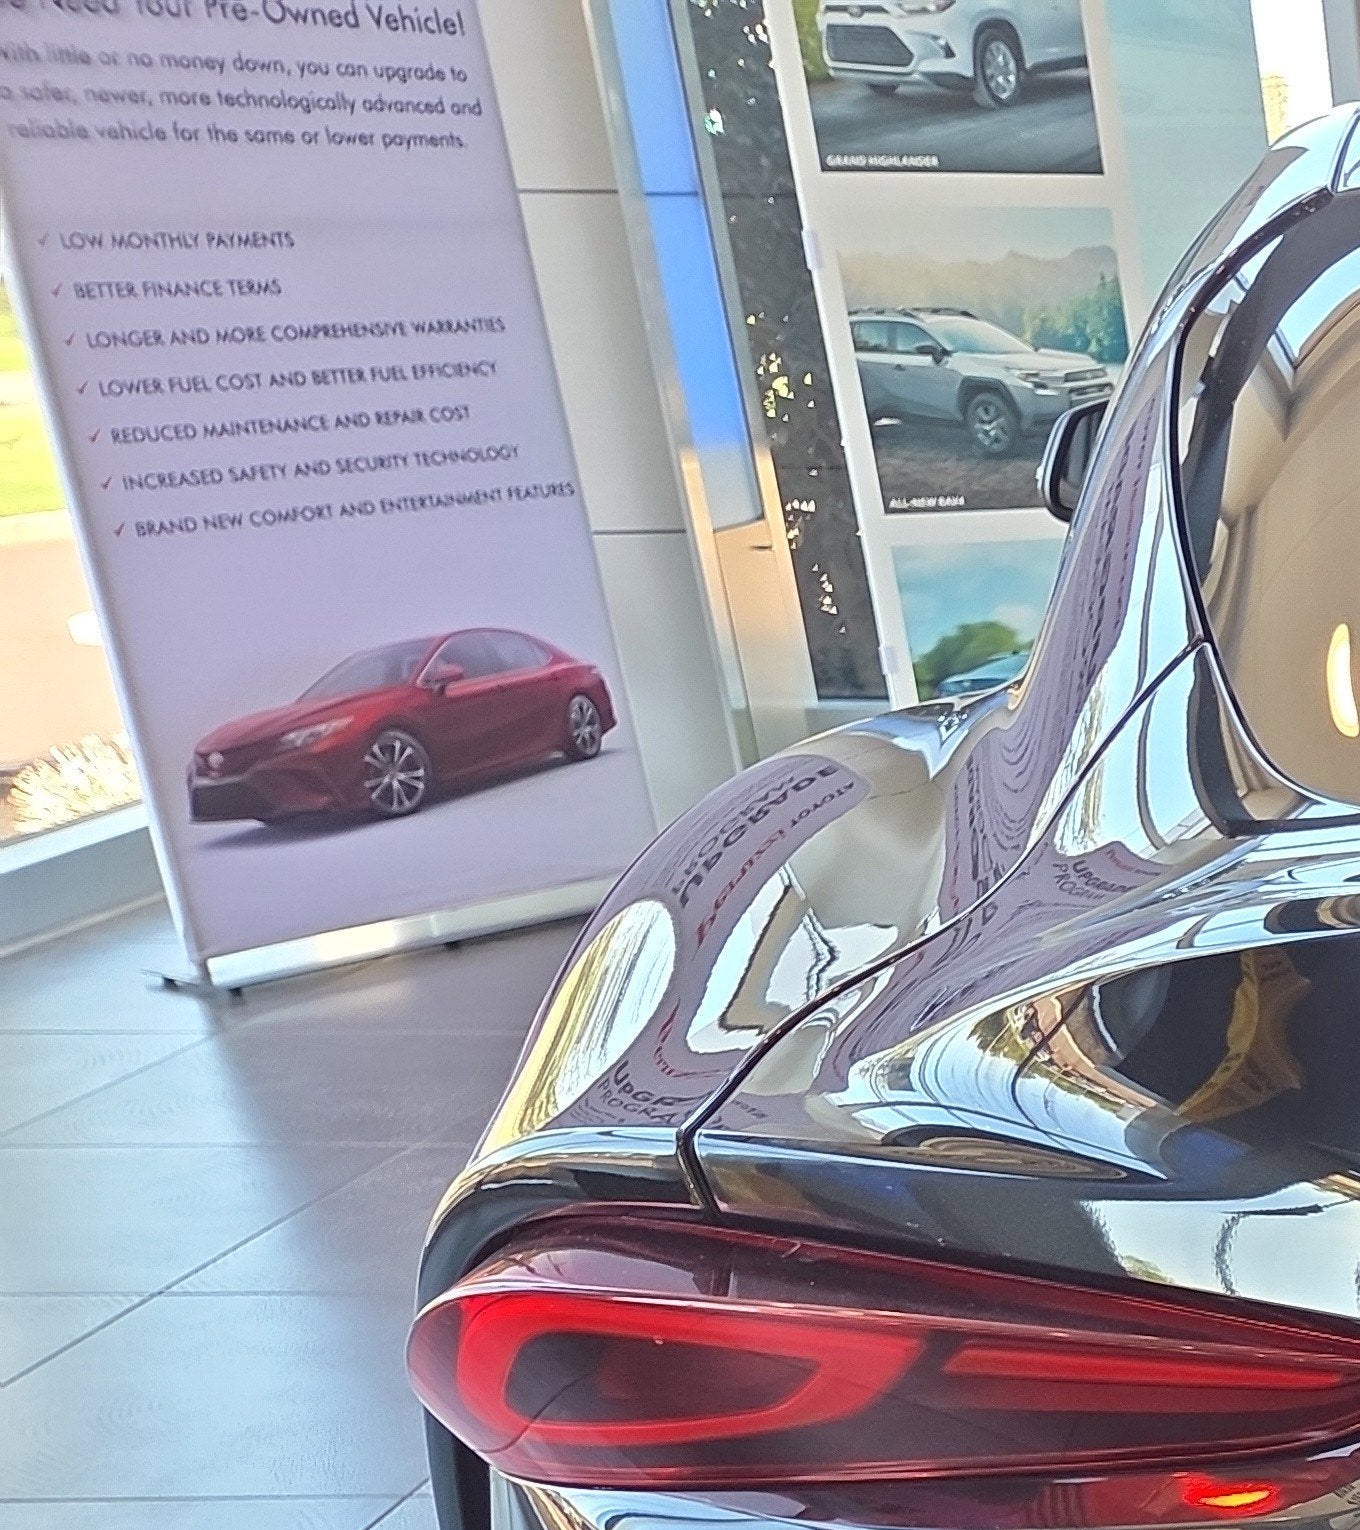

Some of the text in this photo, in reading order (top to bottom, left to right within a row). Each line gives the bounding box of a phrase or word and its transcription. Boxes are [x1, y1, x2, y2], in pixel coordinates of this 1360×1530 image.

[205, 0, 360, 29] Pre-Owned
[366, 3, 466, 37] Vehicle!
[99, 51, 118, 65] or
[127, 52, 153, 68] no
[160, 53, 225, 74] money
[232, 52, 291, 77] down,
[297, 60, 329, 78] you
[336, 61, 368, 78] can
[373, 61, 446, 84] upgrade
[450, 65, 467, 83] to
[84, 87, 152, 106] newer,
[159, 91, 211, 107] more
[217, 88, 355, 116] technologically
[362, 93, 446, 115] advanced
[450, 97, 482, 116] and
[10, 117, 468, 151] reliable vehicle for the same or lower payments.
[60, 231, 295, 250] LOW MONTHLY PAYMENTS
[73, 277, 283, 300] BETTER FINANCE TERMS
[87, 316, 506, 349] LONGER AND MORE COMPREHENSIVE WARRANTIES
[98, 359, 497, 398] LOWER FUEL COST AND BETTER FUEL EFFICIENCY
[110, 404, 471, 445] REDUCED MAINTENANCE AND REPAIR COST
[122, 443, 520, 491] INCREASED SAFETY AND SECURITY TECHNOLOGY
[134, 516, 198, 538] BRAND
[202, 513, 244, 531] NEW
[249, 503, 334, 529] COMFORT
[339, 500, 376, 518] AND
[506, 480, 577, 502] FEATURES
